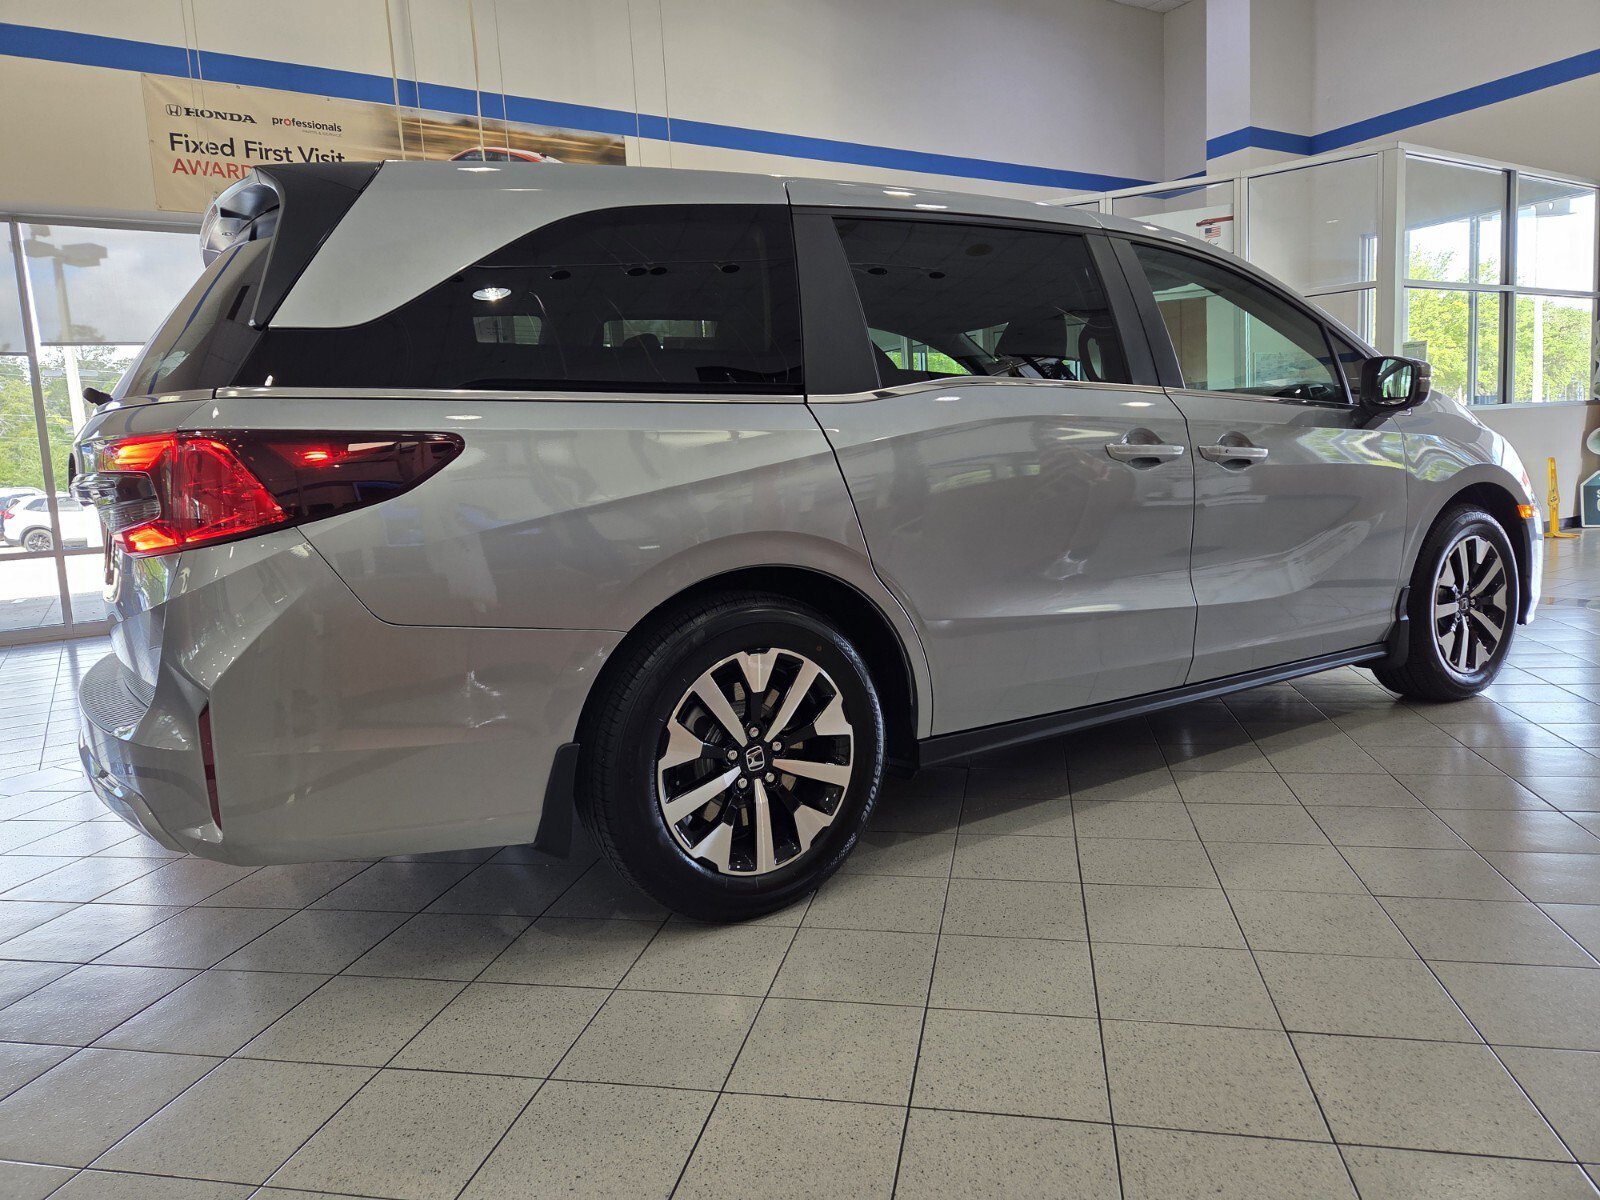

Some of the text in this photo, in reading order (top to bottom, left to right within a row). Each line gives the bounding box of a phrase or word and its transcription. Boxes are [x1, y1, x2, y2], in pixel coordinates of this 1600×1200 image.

[184, 107, 257, 124] HONDA
[272, 117, 342, 132] professionals
[169, 132, 345, 163] Fixed First Visit
